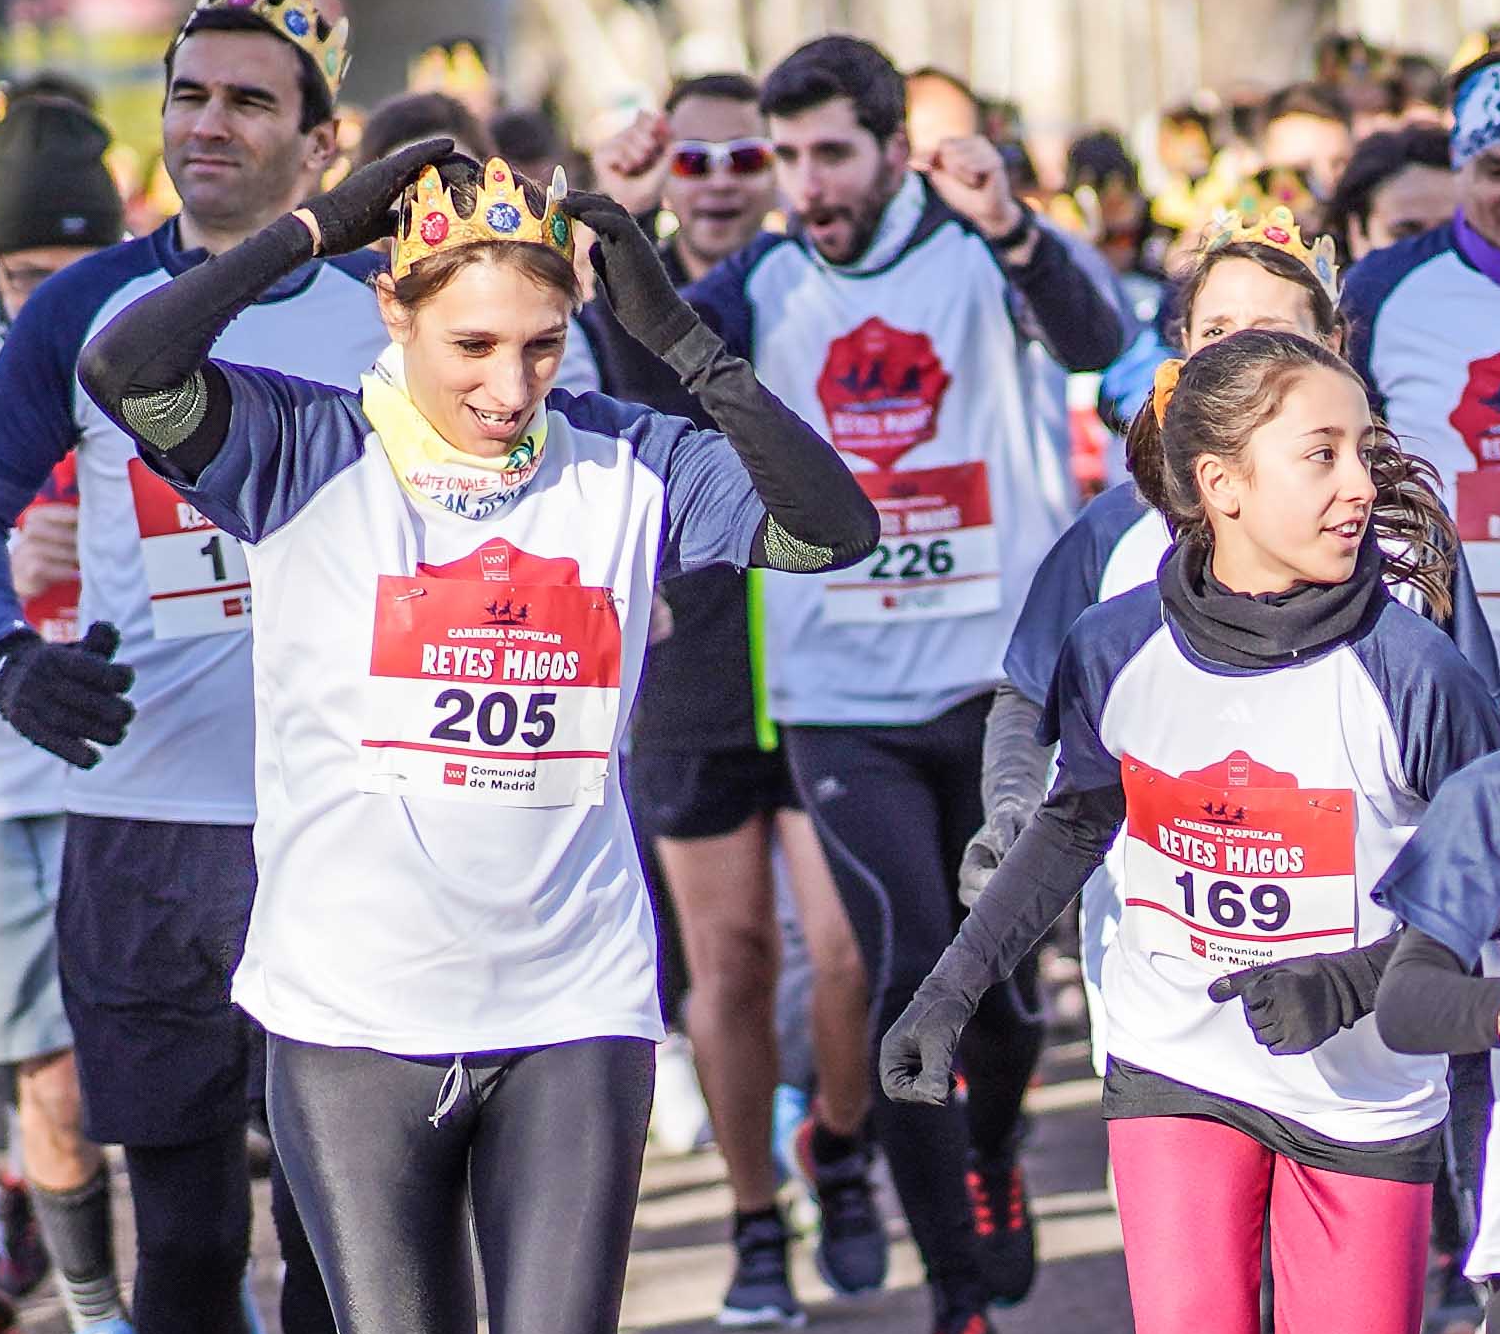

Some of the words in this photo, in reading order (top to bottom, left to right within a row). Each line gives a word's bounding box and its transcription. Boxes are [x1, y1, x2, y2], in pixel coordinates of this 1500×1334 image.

[869, 539, 955, 580] 226
[448, 628, 505, 640] CARRERA
[508, 629, 562, 644] POPULAR
[421, 643, 495, 679] REYES
[503, 649, 580, 682] MAGOS
[429, 688, 558, 748] 205
[471, 765, 537, 778] Comunidad
[469, 778, 486, 789] de
[490, 779, 536, 792] Madrid
[1173, 817, 1224, 836] CARRERA
[1226, 827, 1283, 842] POPULAR
[1157, 824, 1217, 868] REYES
[1225, 845, 1305, 874] MAGOS
[1175, 870, 1291, 932] 169
[1208, 941, 1273, 958] Comunidad
[1208, 953, 1224, 963] de
